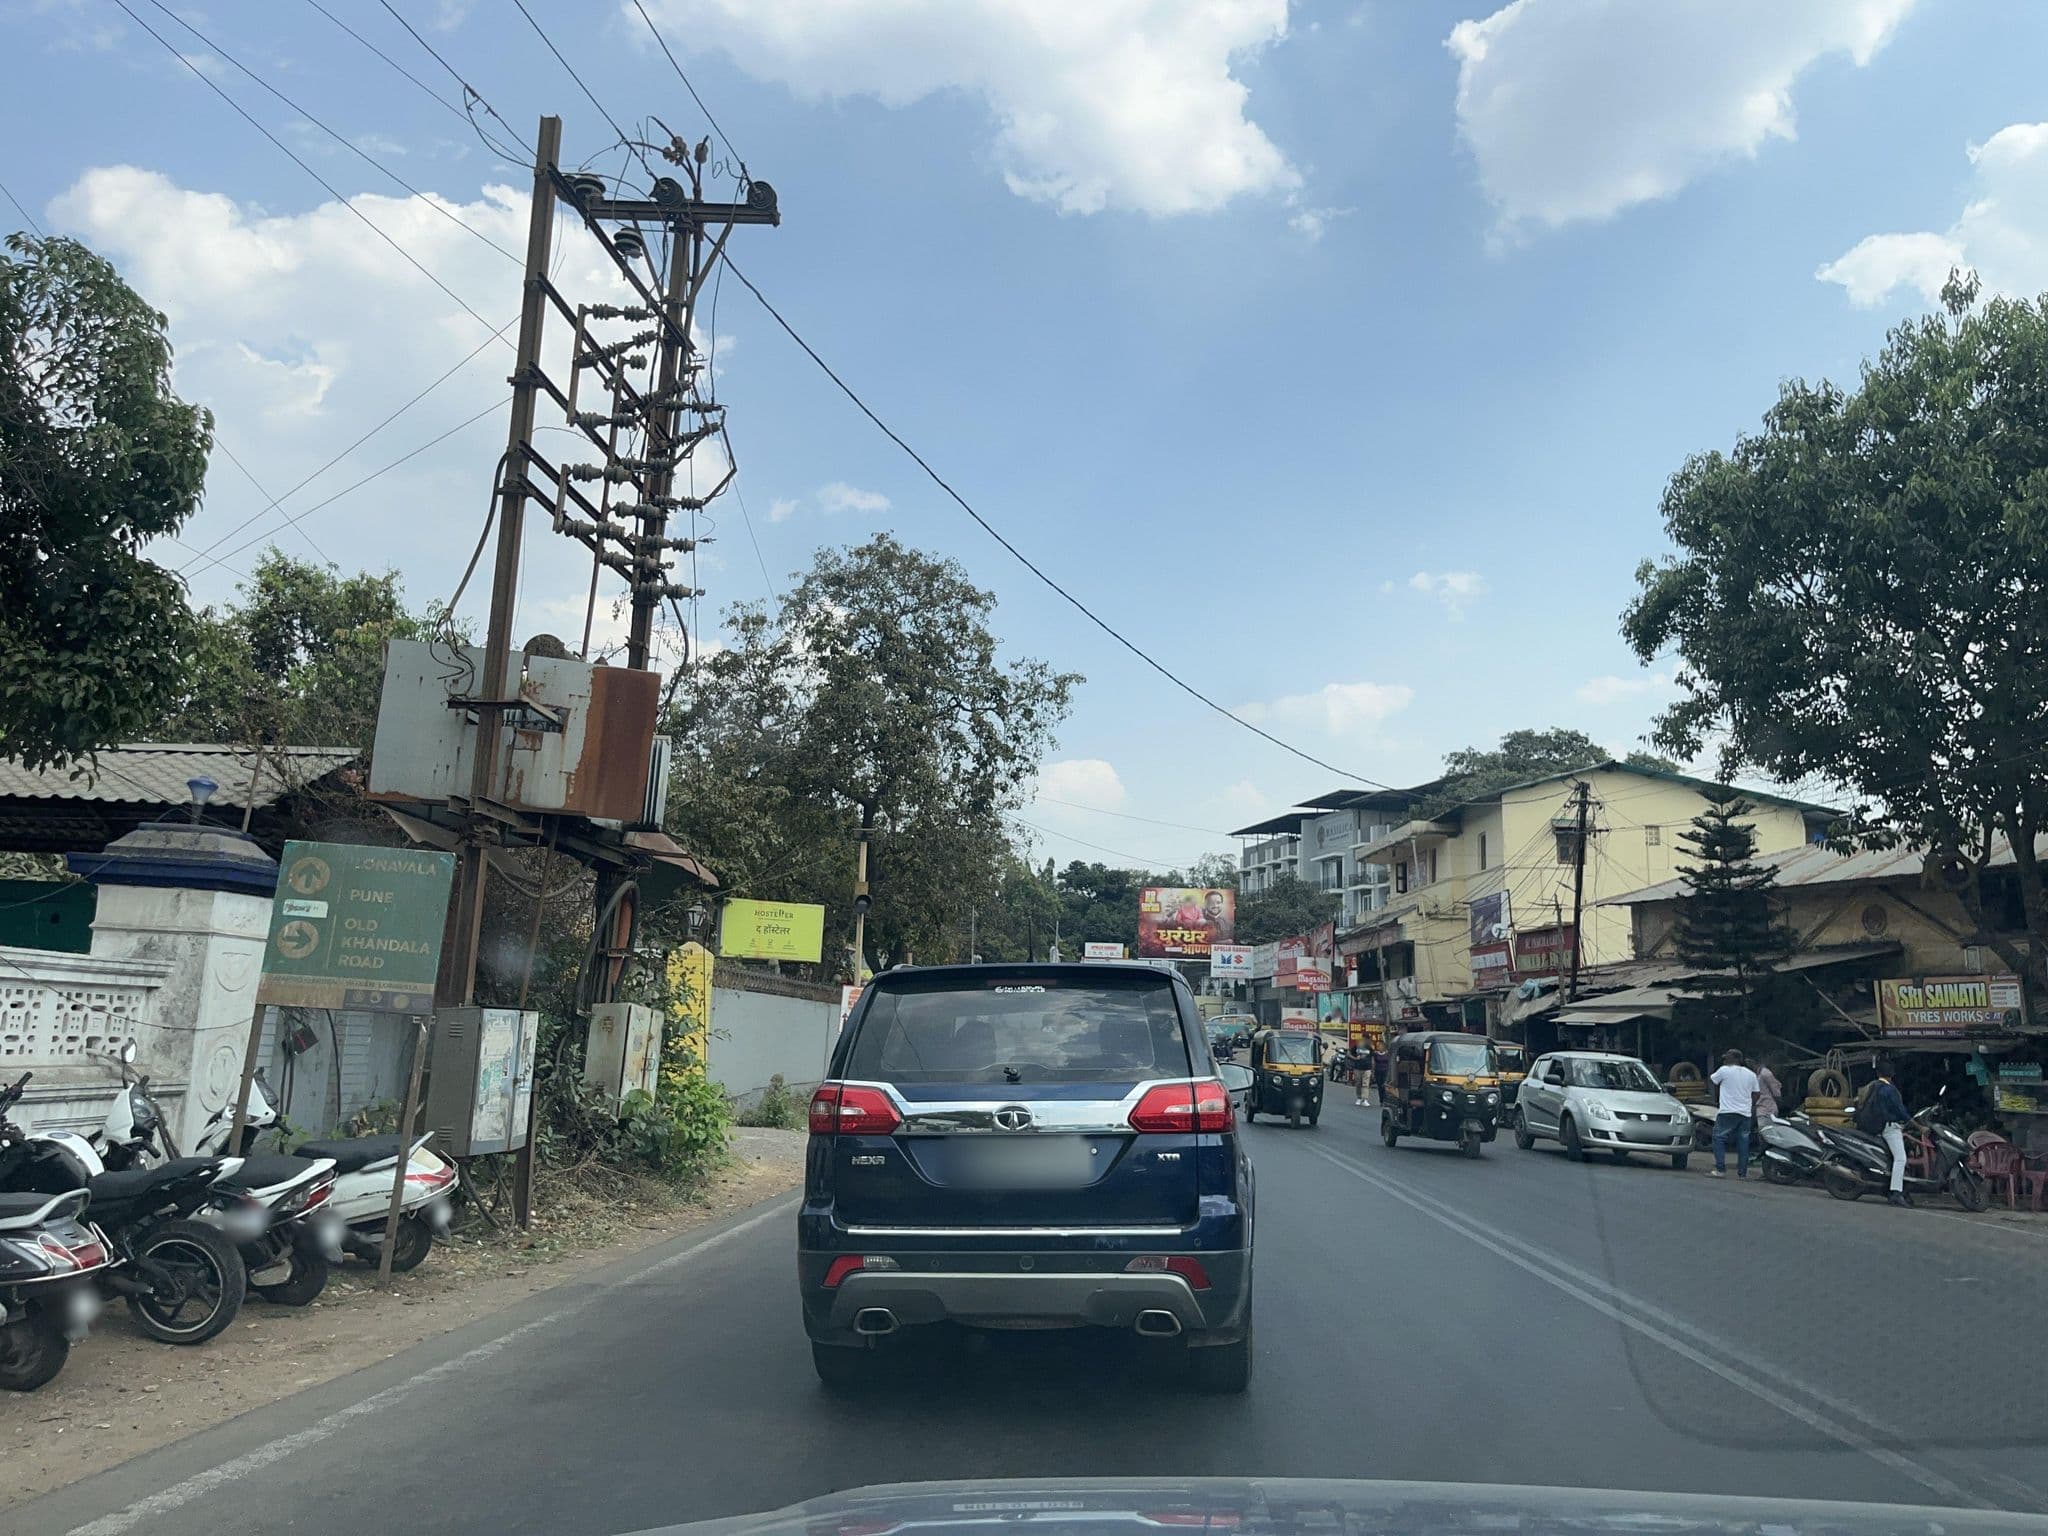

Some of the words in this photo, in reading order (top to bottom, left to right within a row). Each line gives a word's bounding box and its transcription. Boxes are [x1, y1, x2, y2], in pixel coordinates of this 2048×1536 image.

[355, 858, 436, 876] ONAVALA
[350, 888, 394, 904] PUNE
[344, 917, 379, 932] OLD
[341, 936, 431, 955] KHANDALA
[337, 954, 385, 969] ROAD
[1898, 984, 1924, 1009] SRI
[1924, 982, 1988, 1008] SAINATH
[1907, 1011, 1940, 1023] TYRES
[1943, 1010, 1984, 1023] WORKS
